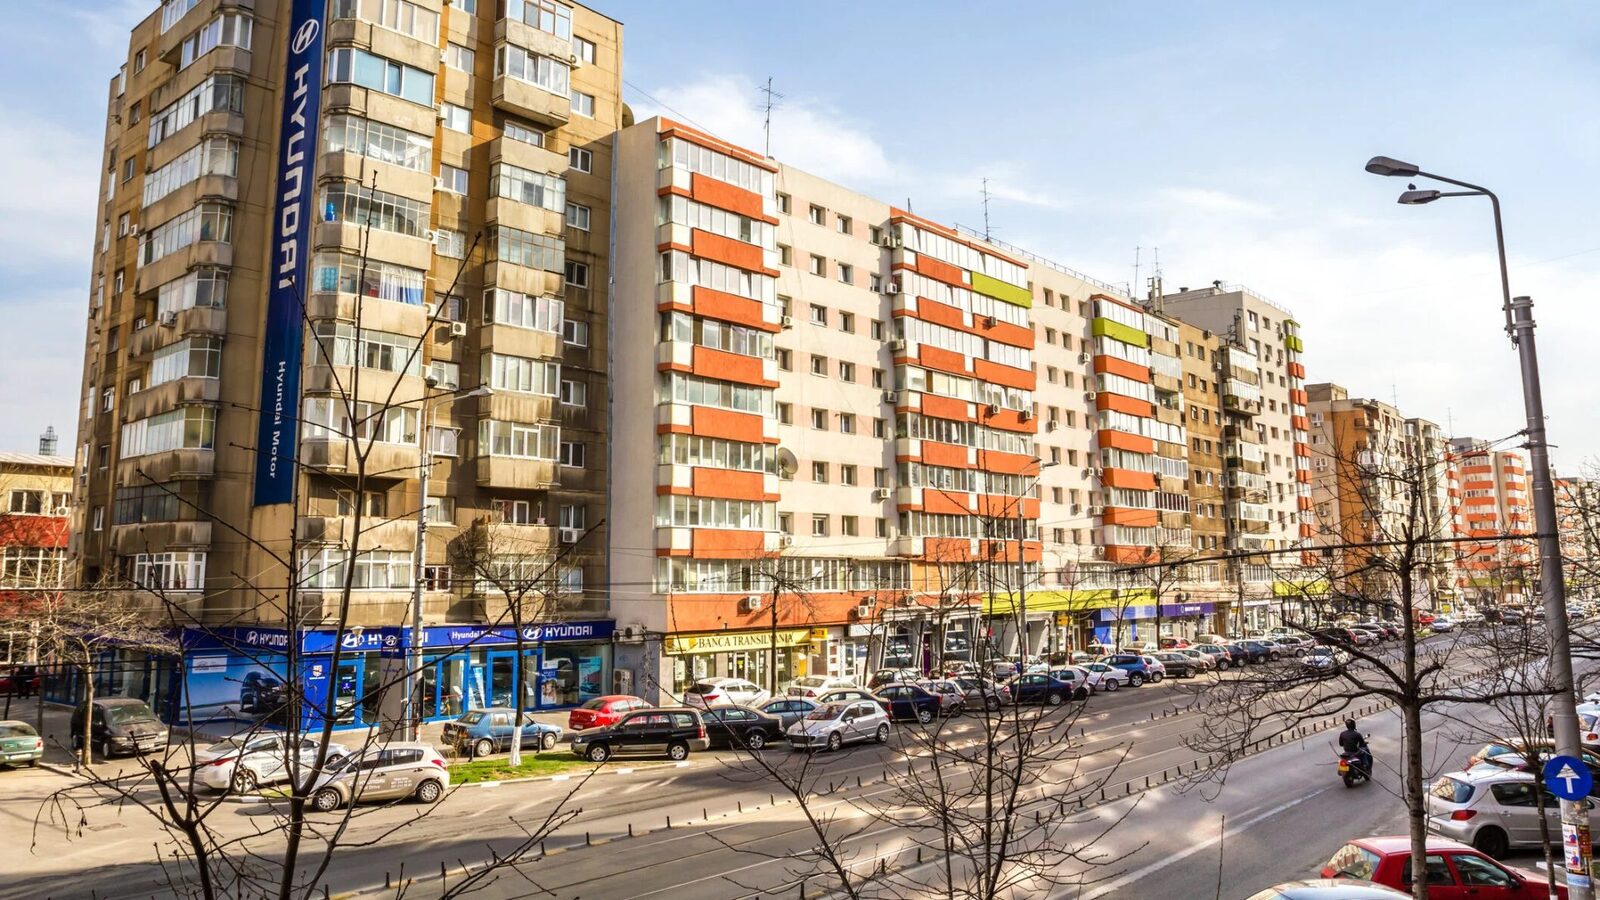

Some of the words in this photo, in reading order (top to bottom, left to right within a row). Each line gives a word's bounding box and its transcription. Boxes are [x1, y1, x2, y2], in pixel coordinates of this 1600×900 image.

[278, 63, 309, 289] HYUNDAI
[274, 361, 286, 425] Hyundai
[269, 430, 281, 478] Motor
[452, 630, 480, 641] Hyundai
[545, 625, 593, 638] HYUNDAI
[259, 633, 289, 647] HYUNDA
[698, 637, 731, 649] BANCA
[731, 633, 794, 646] TRANSILVNIA
